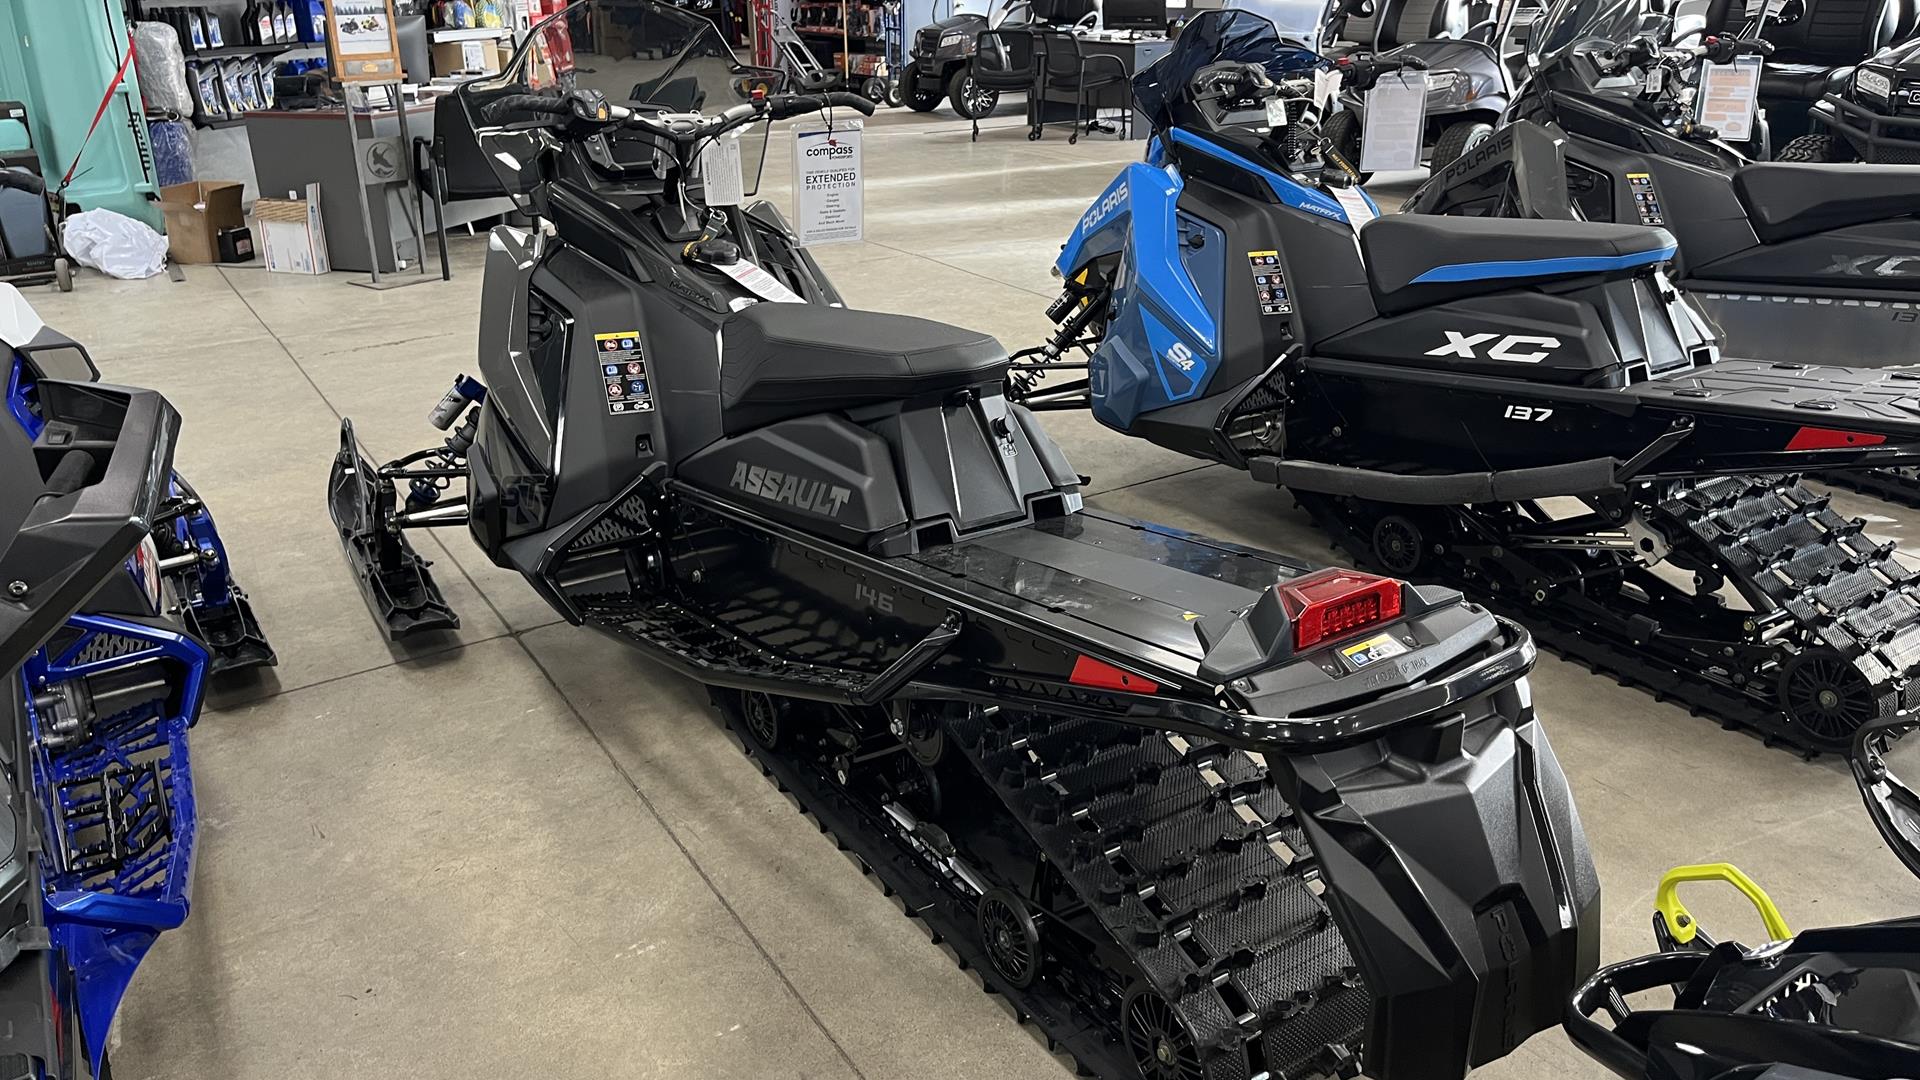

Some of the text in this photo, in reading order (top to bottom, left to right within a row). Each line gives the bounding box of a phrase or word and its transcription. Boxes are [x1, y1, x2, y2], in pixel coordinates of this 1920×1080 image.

[806, 146, 853, 160] compass
[1446, 134, 1513, 183] POLARIS
[806, 172, 856, 185] EXTENDED
[806, 182, 856, 191] PROTECTION
[1082, 181, 1128, 234] POLARIS
[1299, 201, 1342, 221] MATRYX
[1167, 343, 1195, 371] S4
[1423, 331, 1561, 363] XC
[1504, 405, 1553, 421] 137
[730, 461, 851, 517] ASSAULT
[855, 584, 894, 613] 146
